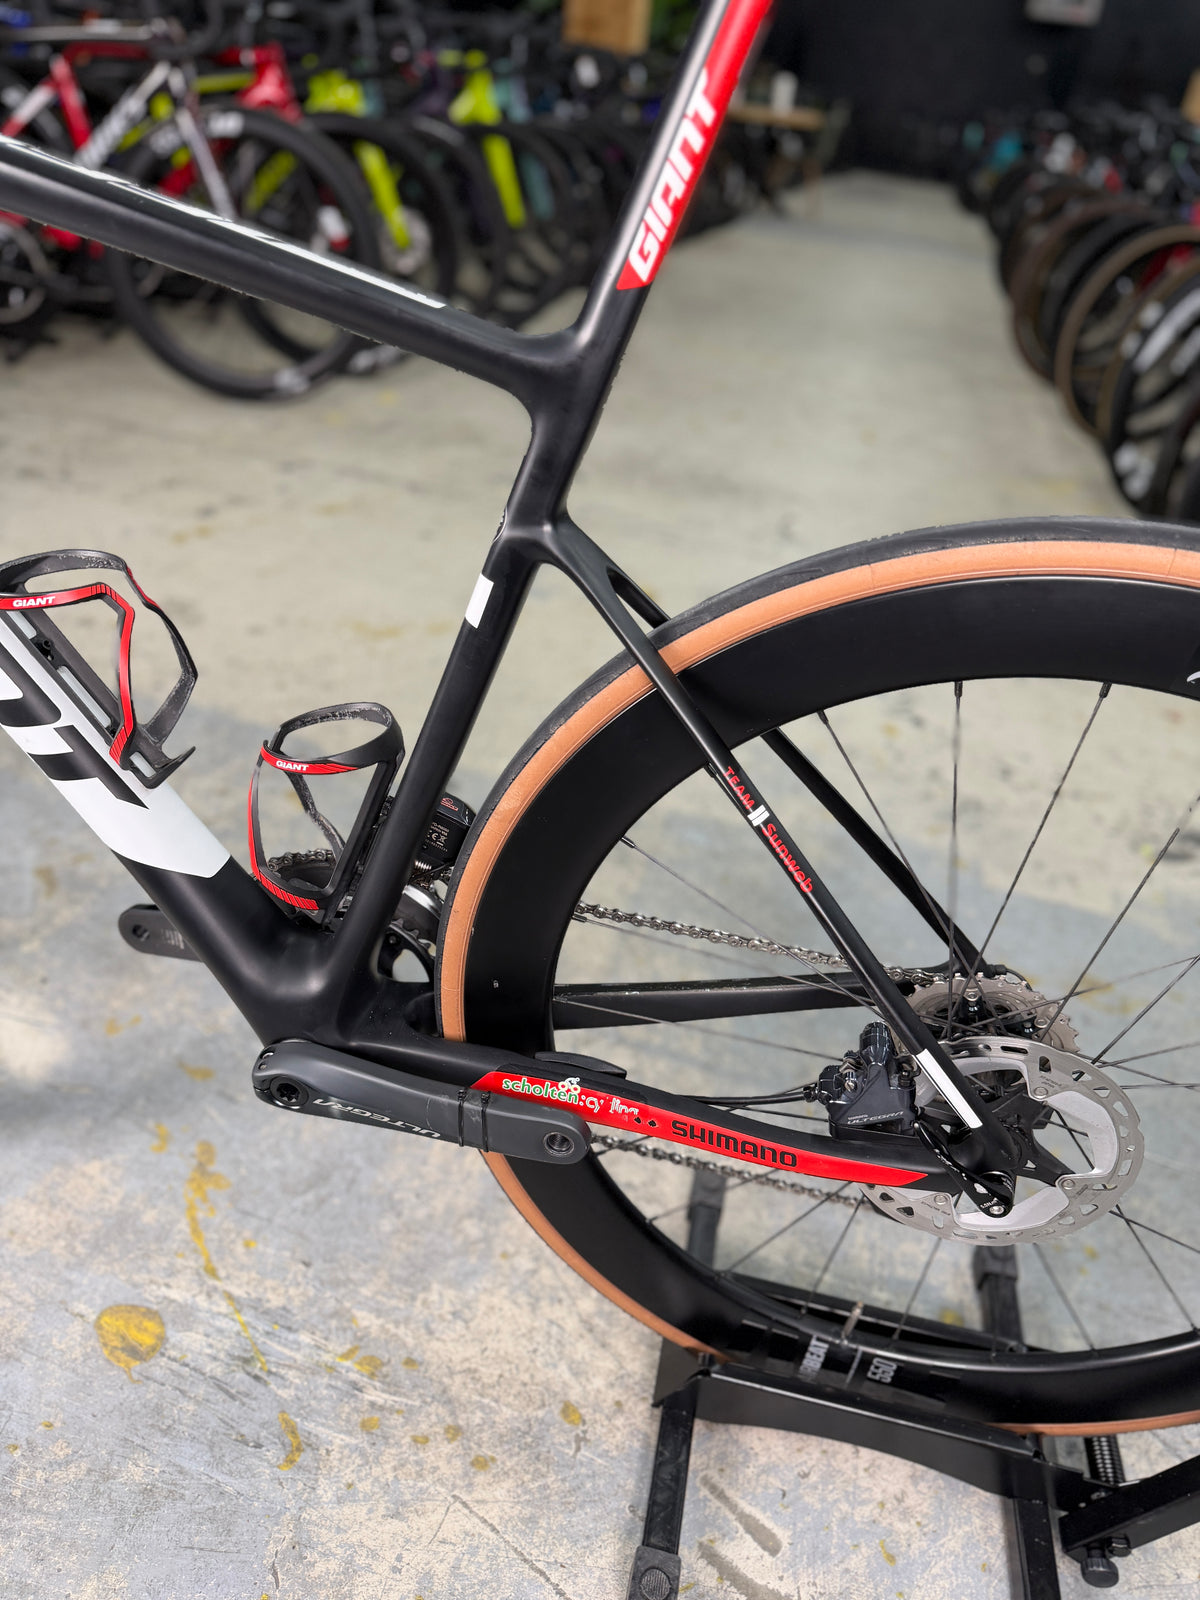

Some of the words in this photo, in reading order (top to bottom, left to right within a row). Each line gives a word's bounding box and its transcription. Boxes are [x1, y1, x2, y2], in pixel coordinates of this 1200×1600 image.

[628, 67, 716, 283] GIANT
[13, 595, 56, 608] GIANT
[276, 760, 309, 771] GIANT
[723, 766, 756, 810] TEAM
[762, 823, 813, 894] Sunweb
[314, 1099, 441, 1138] ULTEGRA
[673, 1119, 798, 1168] SHIMANO
[867, 1357, 898, 1383] 550
